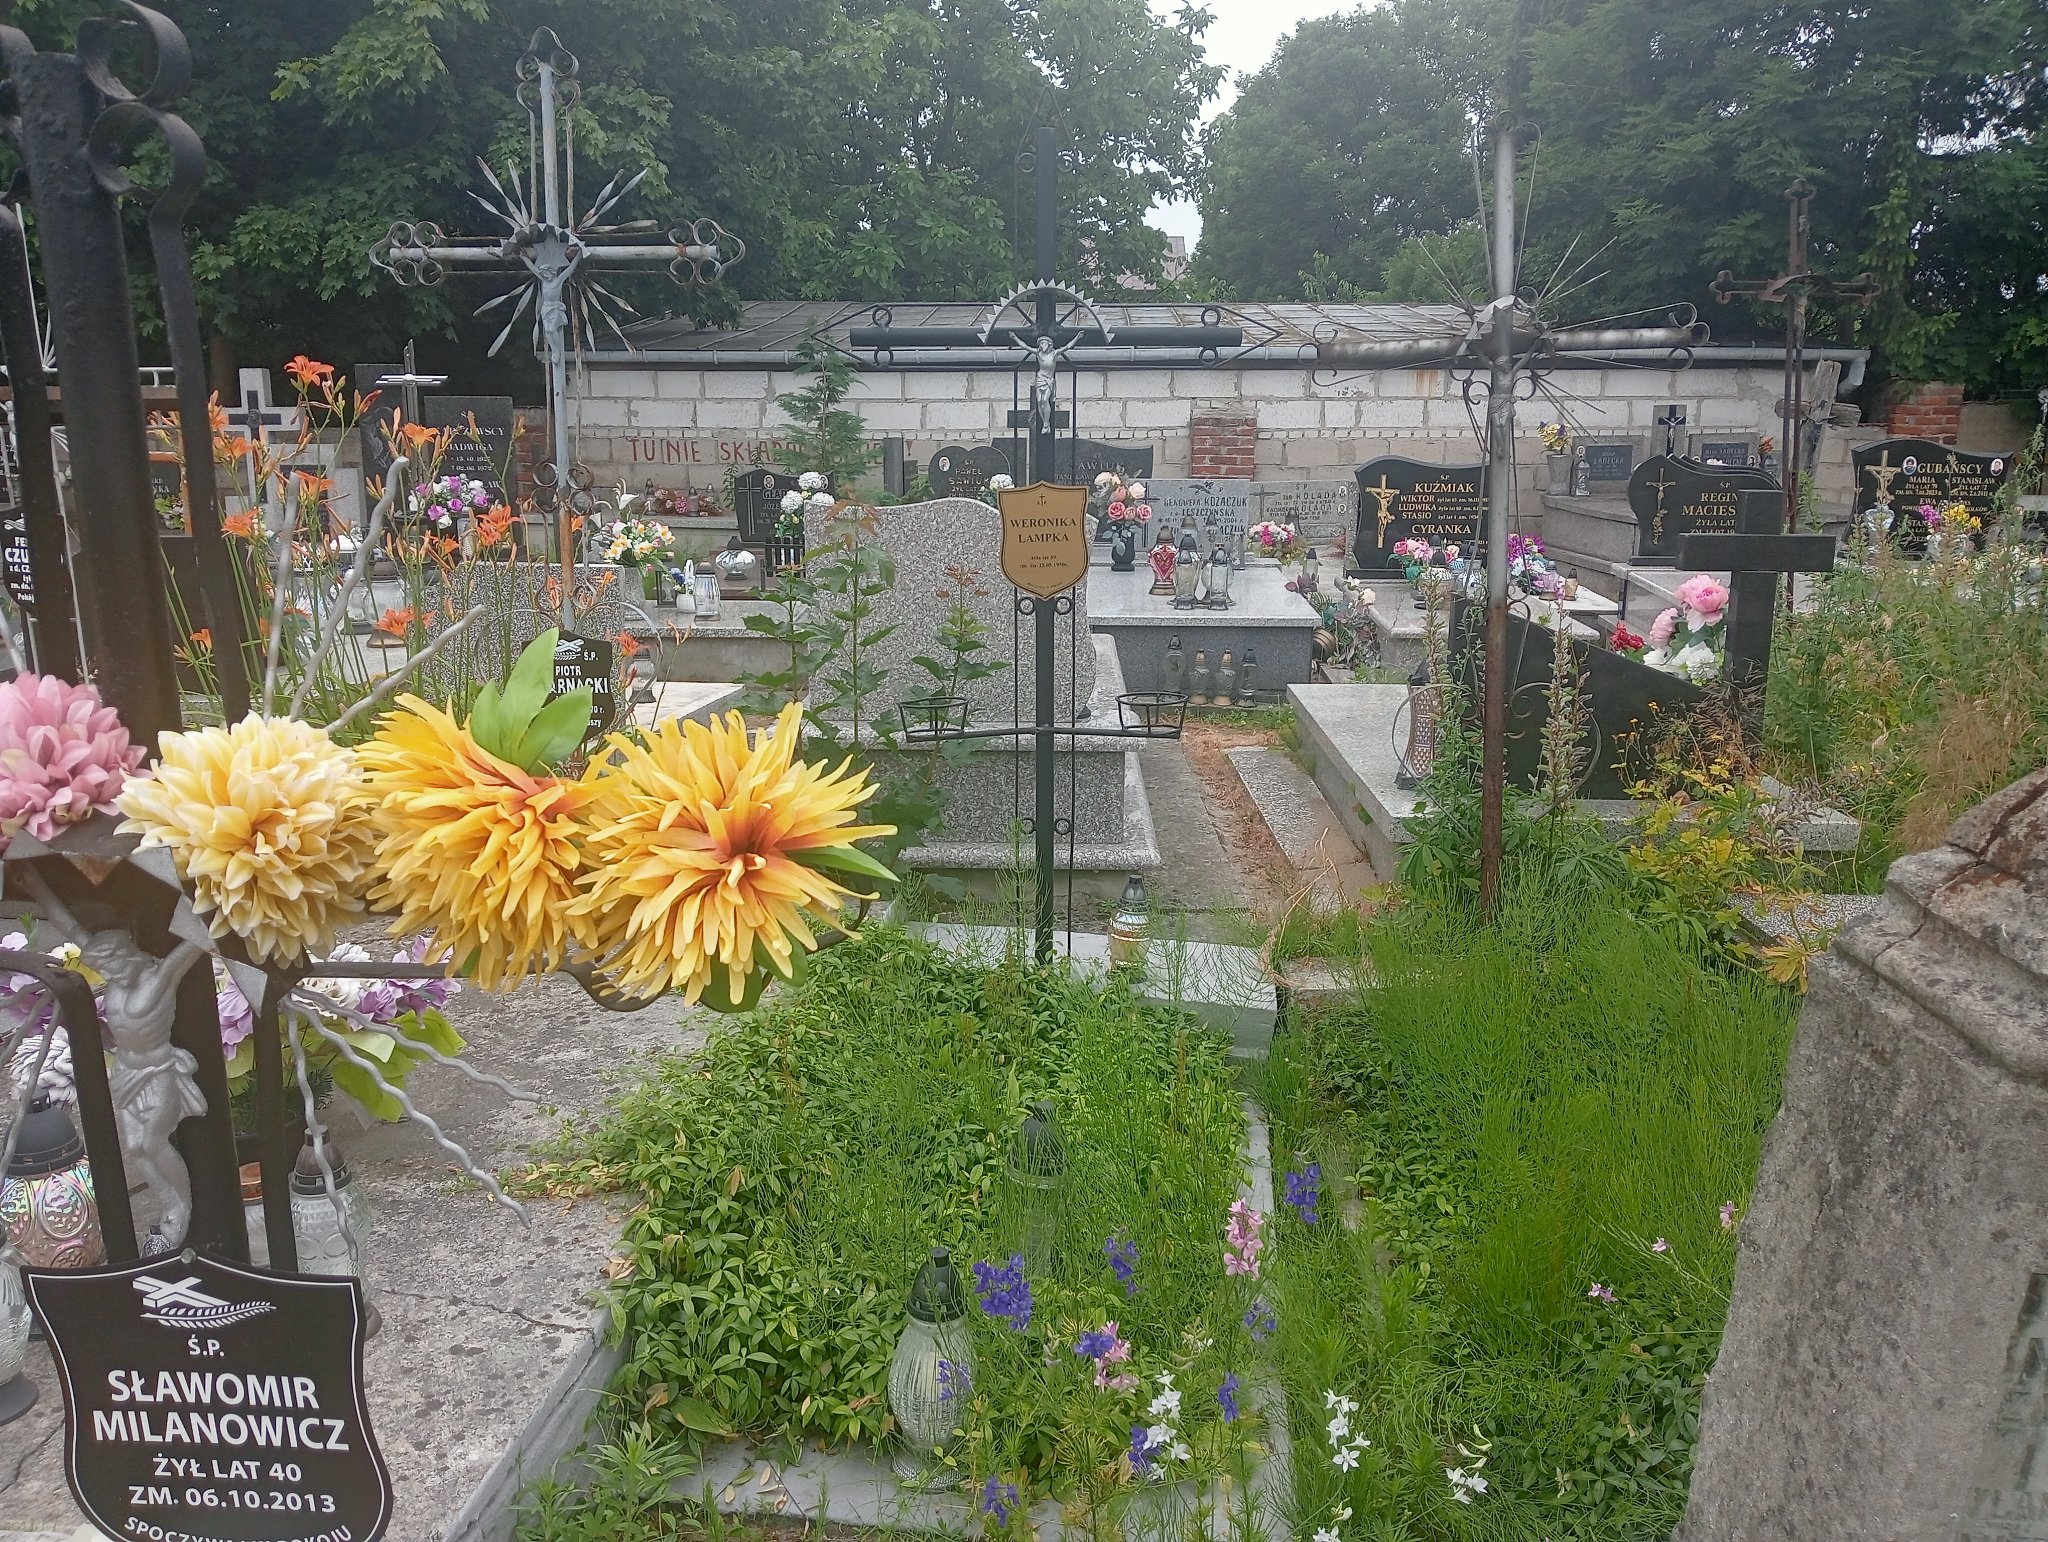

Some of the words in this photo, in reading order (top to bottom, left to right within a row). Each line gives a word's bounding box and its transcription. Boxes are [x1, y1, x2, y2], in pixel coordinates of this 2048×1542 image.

[447, 443, 493, 451] JADWIGA
[630, 438, 655, 461] TU
[666, 440, 701, 462] NIE
[1909, 476, 1936, 484] MARIA
[1414, 480, 1474, 493] KUŹMIAK
[1204, 496, 1248, 507] KOZACZUK
[1400, 494, 1435, 502] WIKTOR
[1700, 492, 1739, 502] REGIN
[763, 502, 780, 510] JÓZE
[1398, 503, 1437, 511] LUDWIKA
[1681, 504, 1737, 516] MACIES
[1402, 511, 1432, 520] STASIO
[1010, 517, 1077, 528] WERONIKA
[1411, 524, 1472, 534] CYRANKA
[1018, 533, 1070, 543] LAMPKA
[555, 665, 582, 676] PIOTR
[549, 677, 609, 694] ARNACKI
[186, 1333, 226, 1358] Ś.P.
[106, 1369, 320, 1410] SŁAWOMIR
[92, 1410, 350, 1451] MILANOWICZ
[152, 1452, 207, 1479] ŻYŁ
[212, 1459, 261, 1480] LAT
[268, 1462, 302, 1482] 40
[128, 1485, 179, 1506] ZM.
[185, 1487, 336, 1514] 06.10.2013
